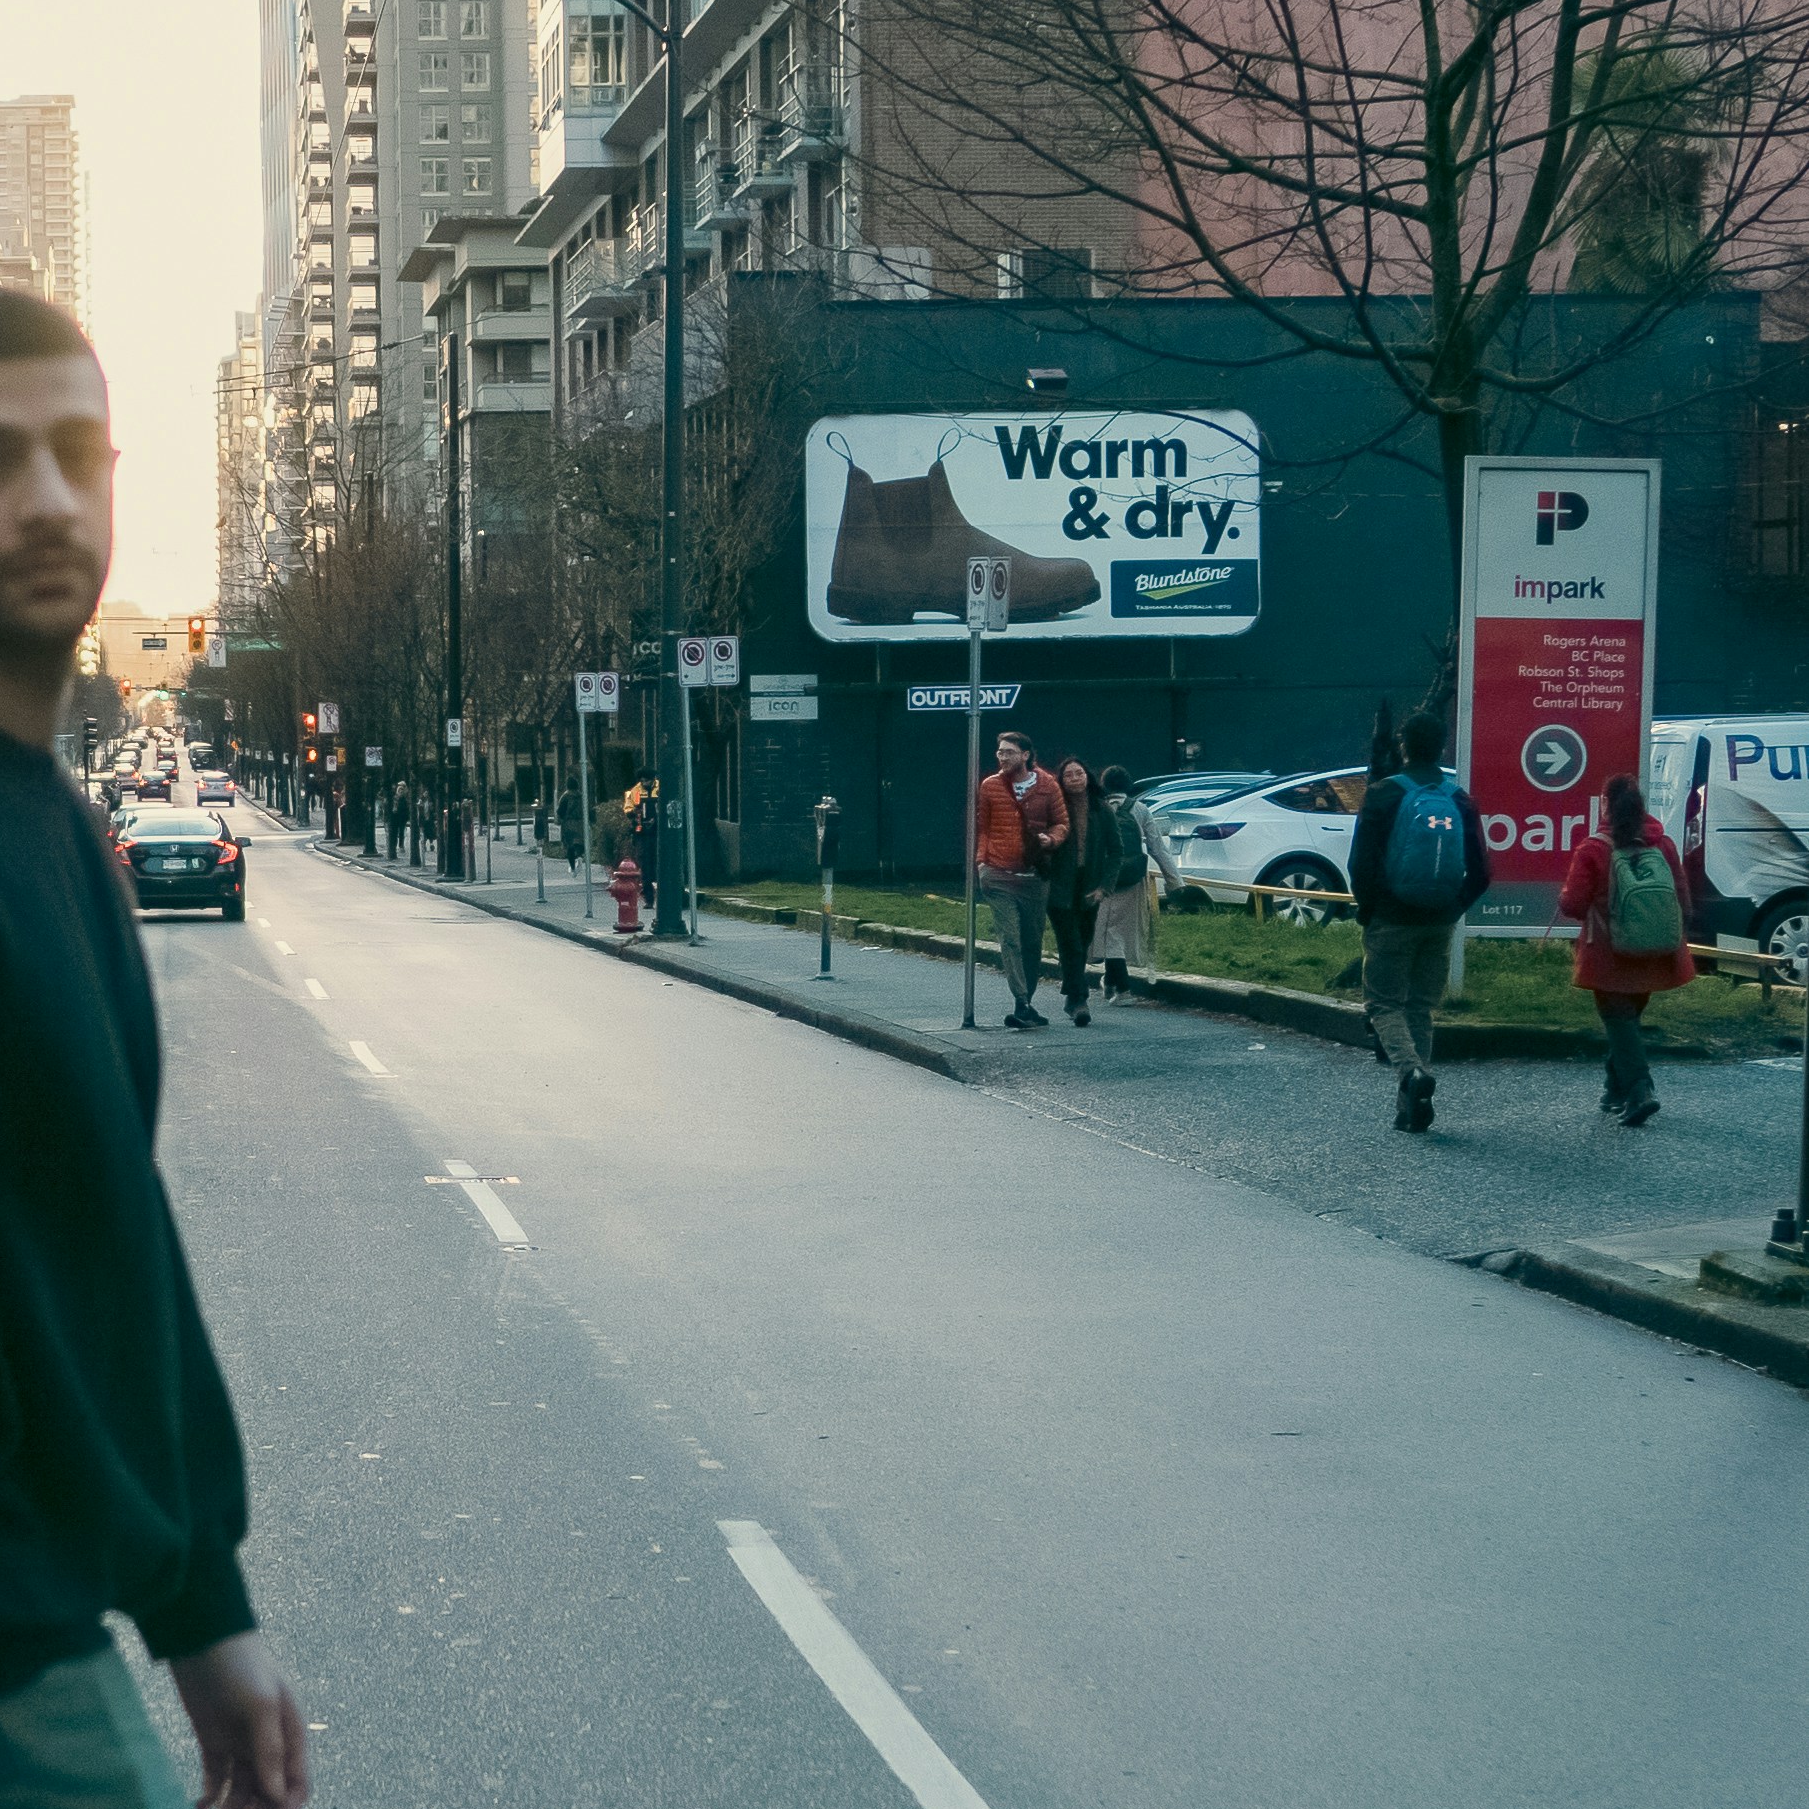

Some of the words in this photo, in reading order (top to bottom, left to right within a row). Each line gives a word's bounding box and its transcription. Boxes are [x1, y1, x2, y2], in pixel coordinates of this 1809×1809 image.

[994, 424, 1188, 480] Warm
[1061, 487, 1111, 541] &
[1124, 483, 1241, 554] dry.
[1134, 566, 1232, 592] Blundstone
[1514, 574, 1605, 604] impark
[1543, 634, 1586, 649] Rogers
[1590, 635, 1626, 647] Arena
[1571, 650, 1589, 662] BC
[1593, 650, 1626, 662] Place
[1518, 665, 1564, 677] Robson
[1568, 666, 1583, 677] St.
[1588, 666, 1625, 681] Shops
[1540, 681, 1563, 692] The
[1566, 681, 1624, 695] Orpheum
[1533, 696, 1578, 708] Central
[1581, 697, 1623, 711] Library
[1483, 905, 1501, 915] Lot
[1503, 905, 1523, 915] 117
